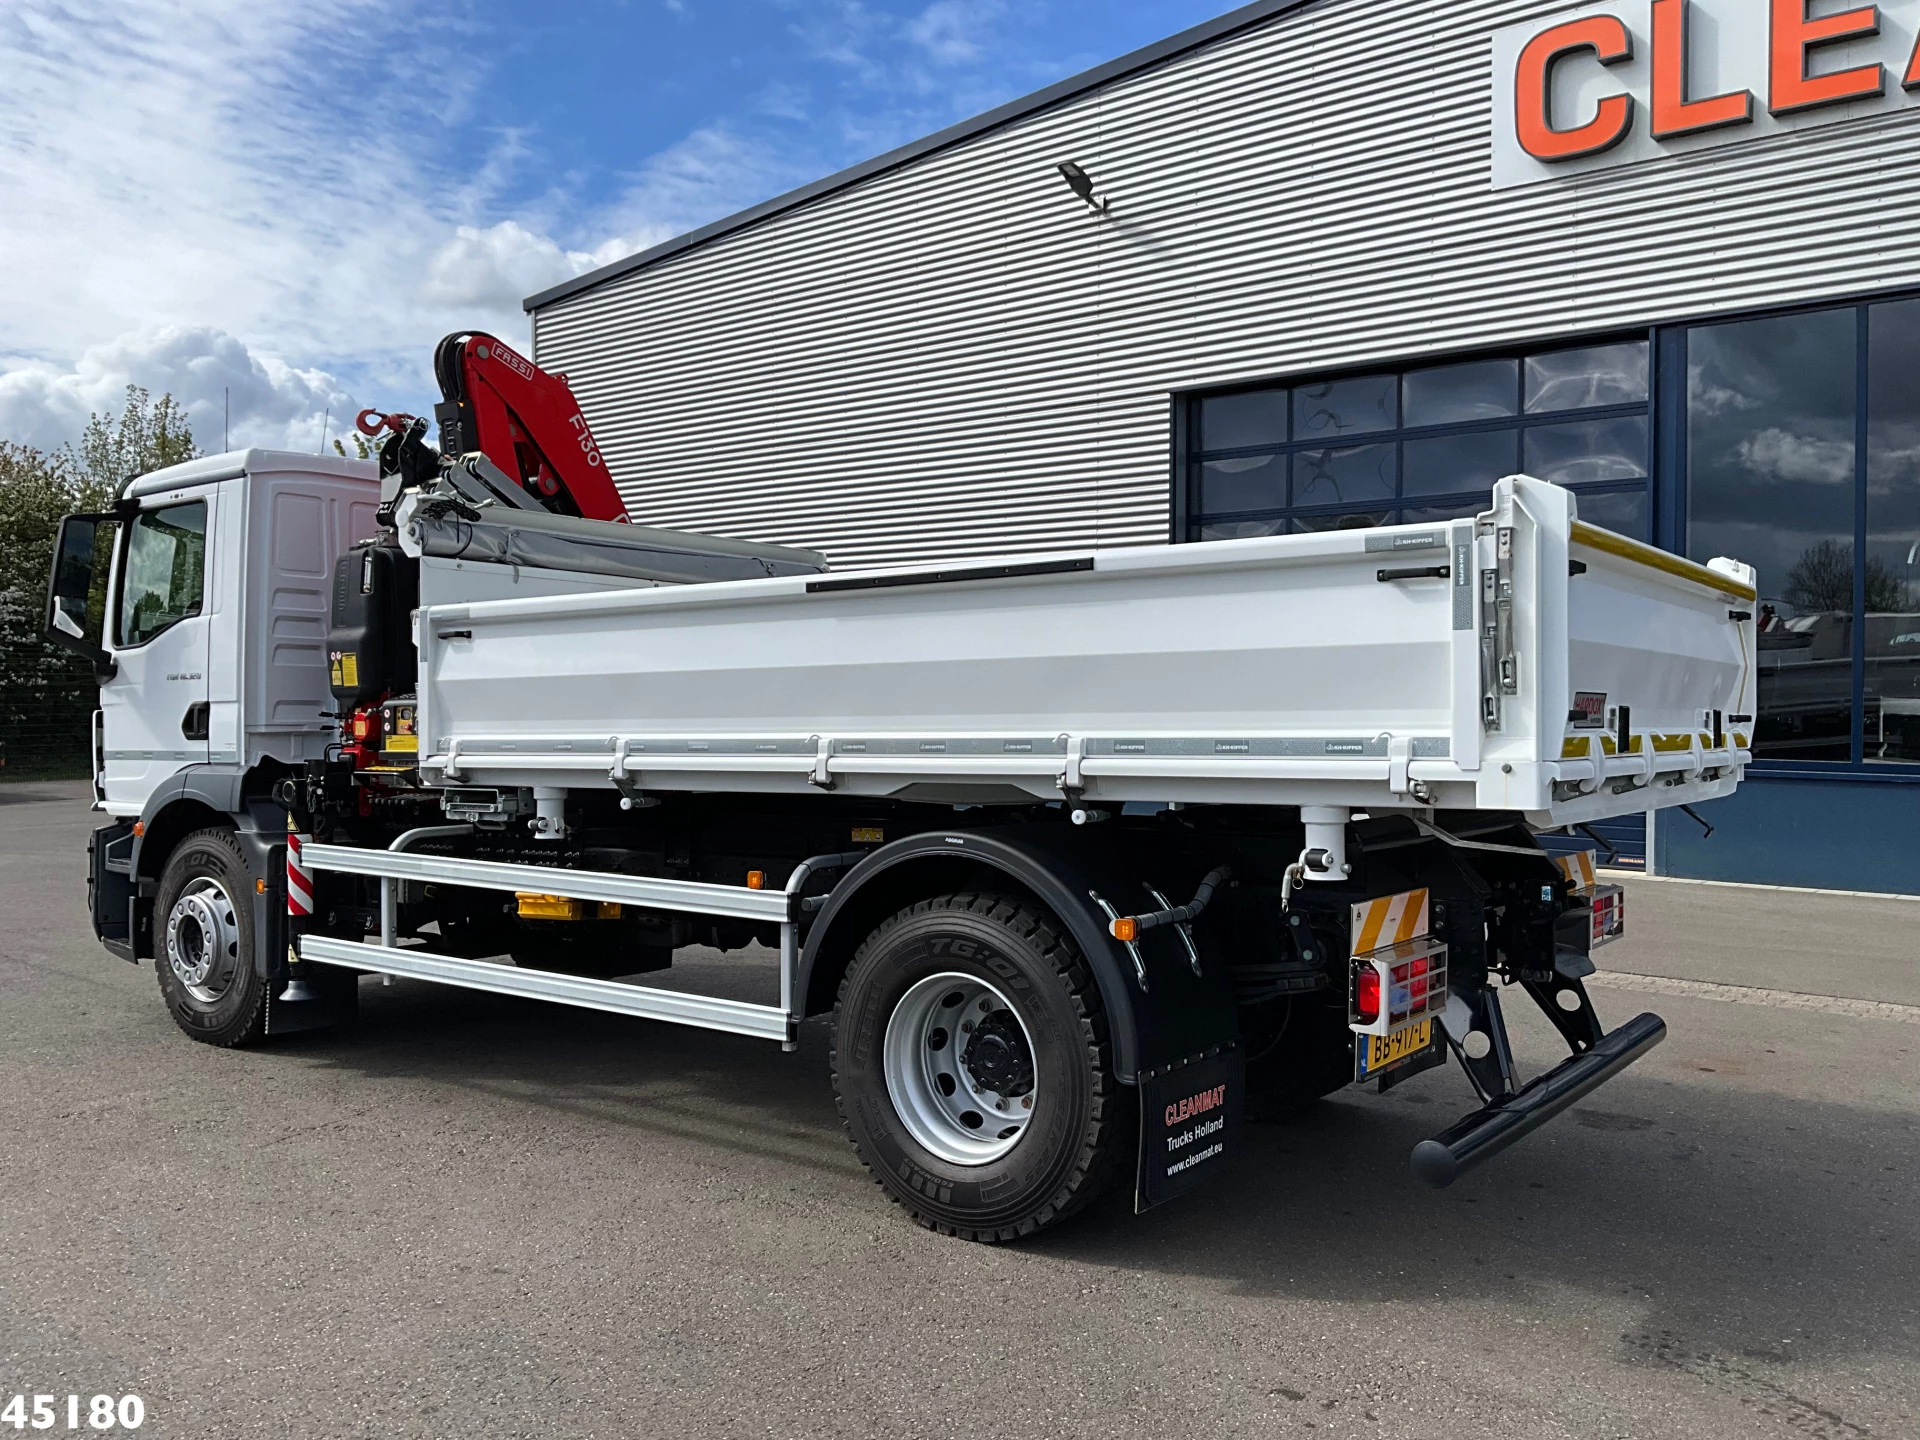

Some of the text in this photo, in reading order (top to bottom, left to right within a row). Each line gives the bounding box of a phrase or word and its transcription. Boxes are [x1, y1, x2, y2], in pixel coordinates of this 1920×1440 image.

[1514, 0, 1920, 162] CLE
[495, 347, 531, 377] FASSI
[568, 413, 600, 467] F130
[1402, 537, 1433, 545] KH-KIPPER
[1165, 1084, 1226, 1127] CLEANMAT
[1166, 1115, 1224, 1152] Trucks Holland
[1166, 1142, 1223, 1177] www.cleanmat.eu
